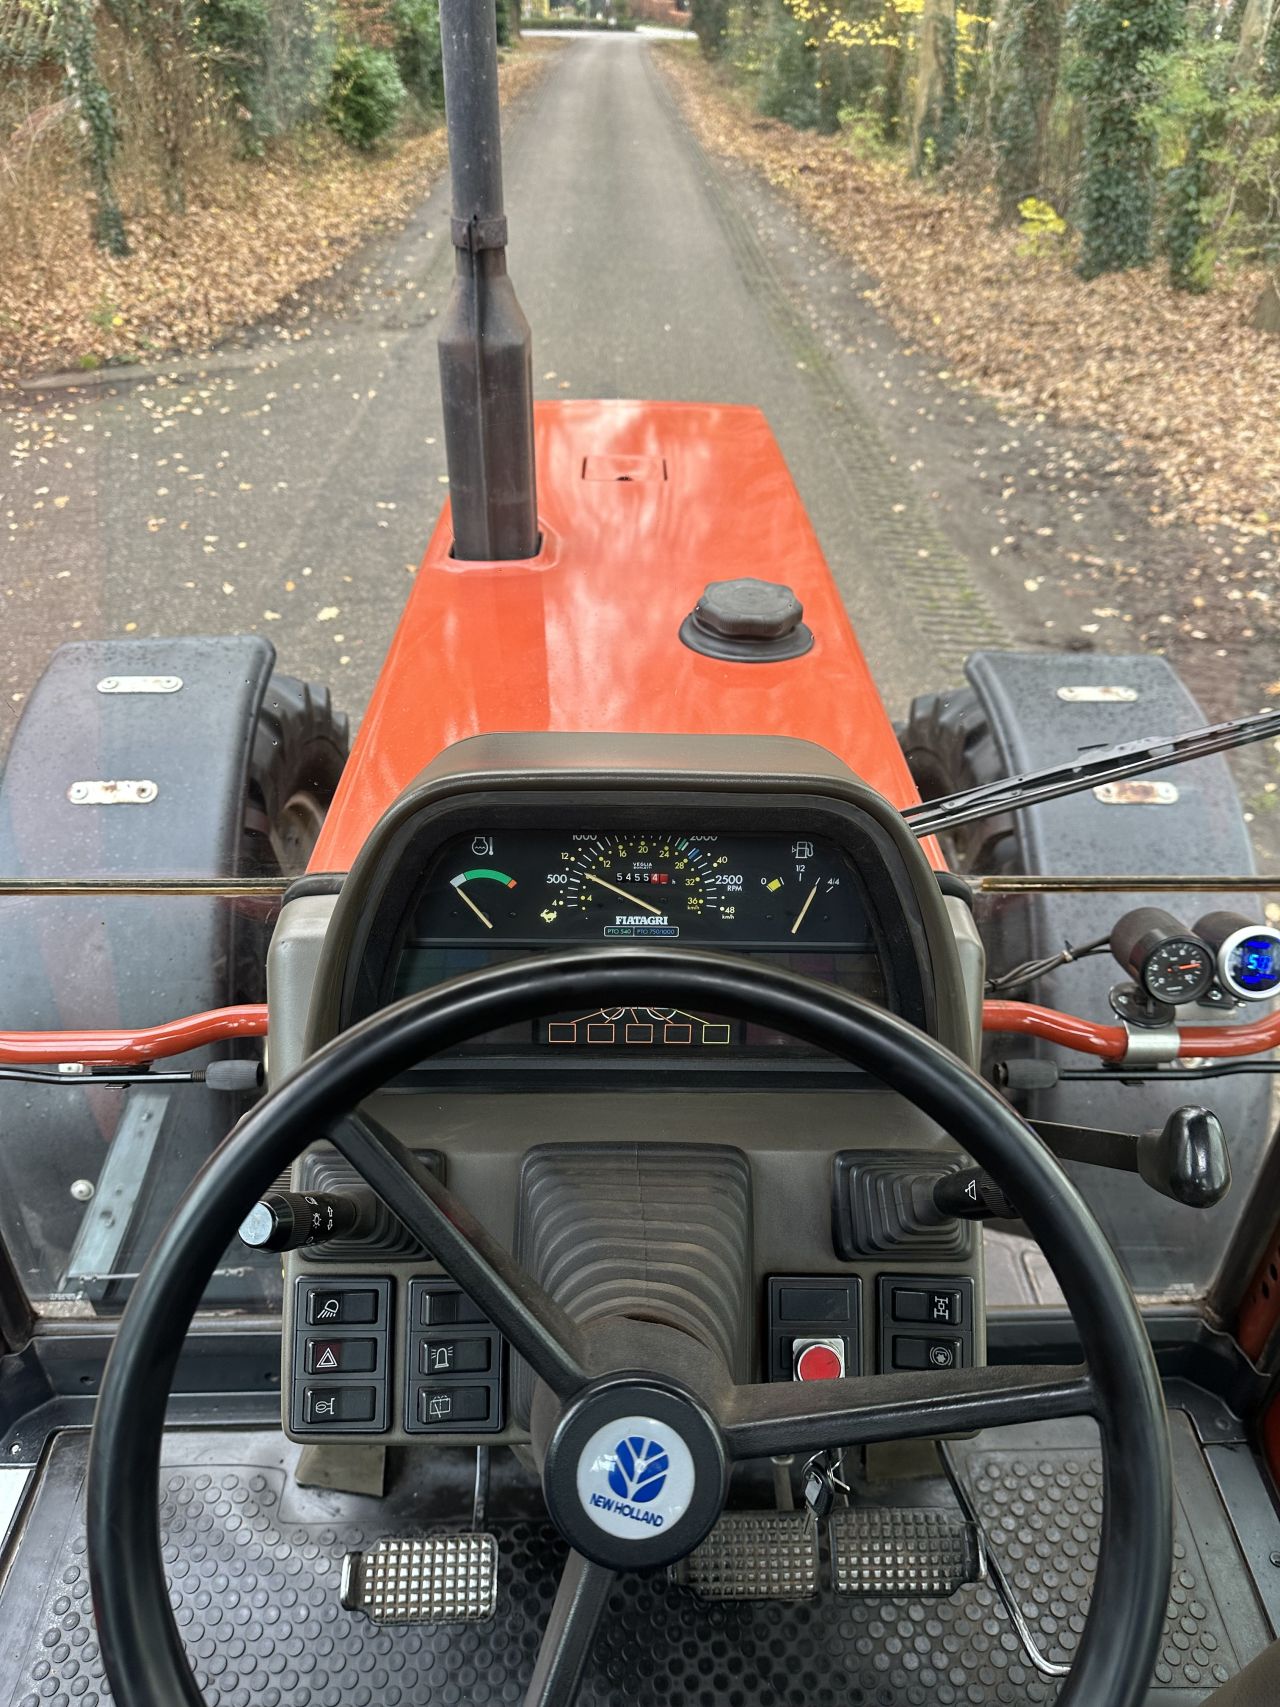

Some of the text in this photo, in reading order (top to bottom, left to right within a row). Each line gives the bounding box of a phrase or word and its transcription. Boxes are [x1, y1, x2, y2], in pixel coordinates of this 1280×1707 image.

[546, 874, 567, 883] 500
[715, 875, 743, 884] 2500
[615, 916, 669, 925] FIATAGRI
[589, 1493, 664, 1527] NEW HOLLAND
